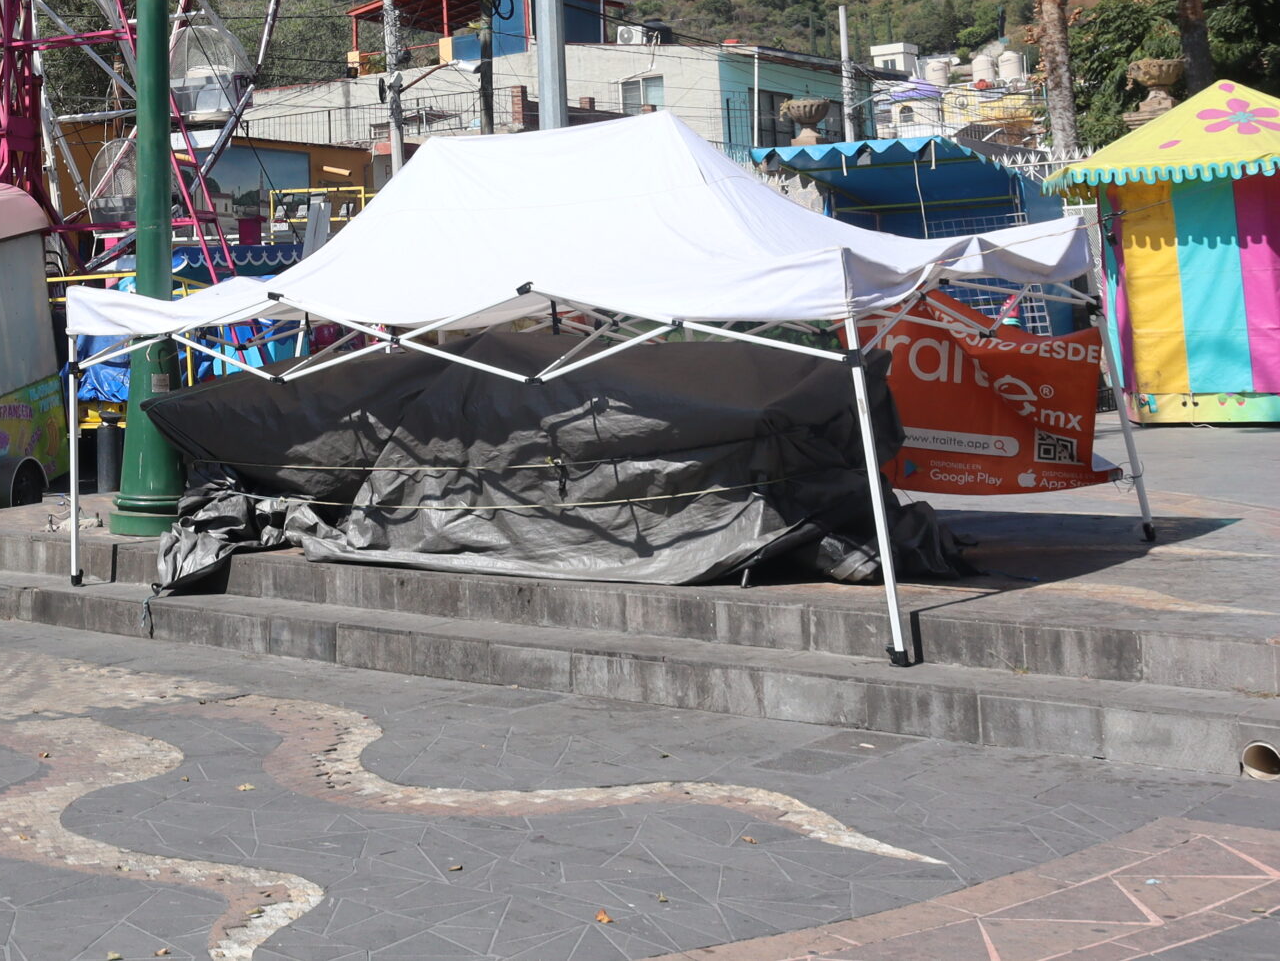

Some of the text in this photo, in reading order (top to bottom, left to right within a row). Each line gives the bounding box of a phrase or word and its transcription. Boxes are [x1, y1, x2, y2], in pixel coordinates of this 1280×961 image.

[1019, 340, 1100, 364] DESDE
[929, 460, 970, 470] DISPONIBLE
[929, 469, 1003, 487] Google Play
[1039, 477, 1067, 489] App
